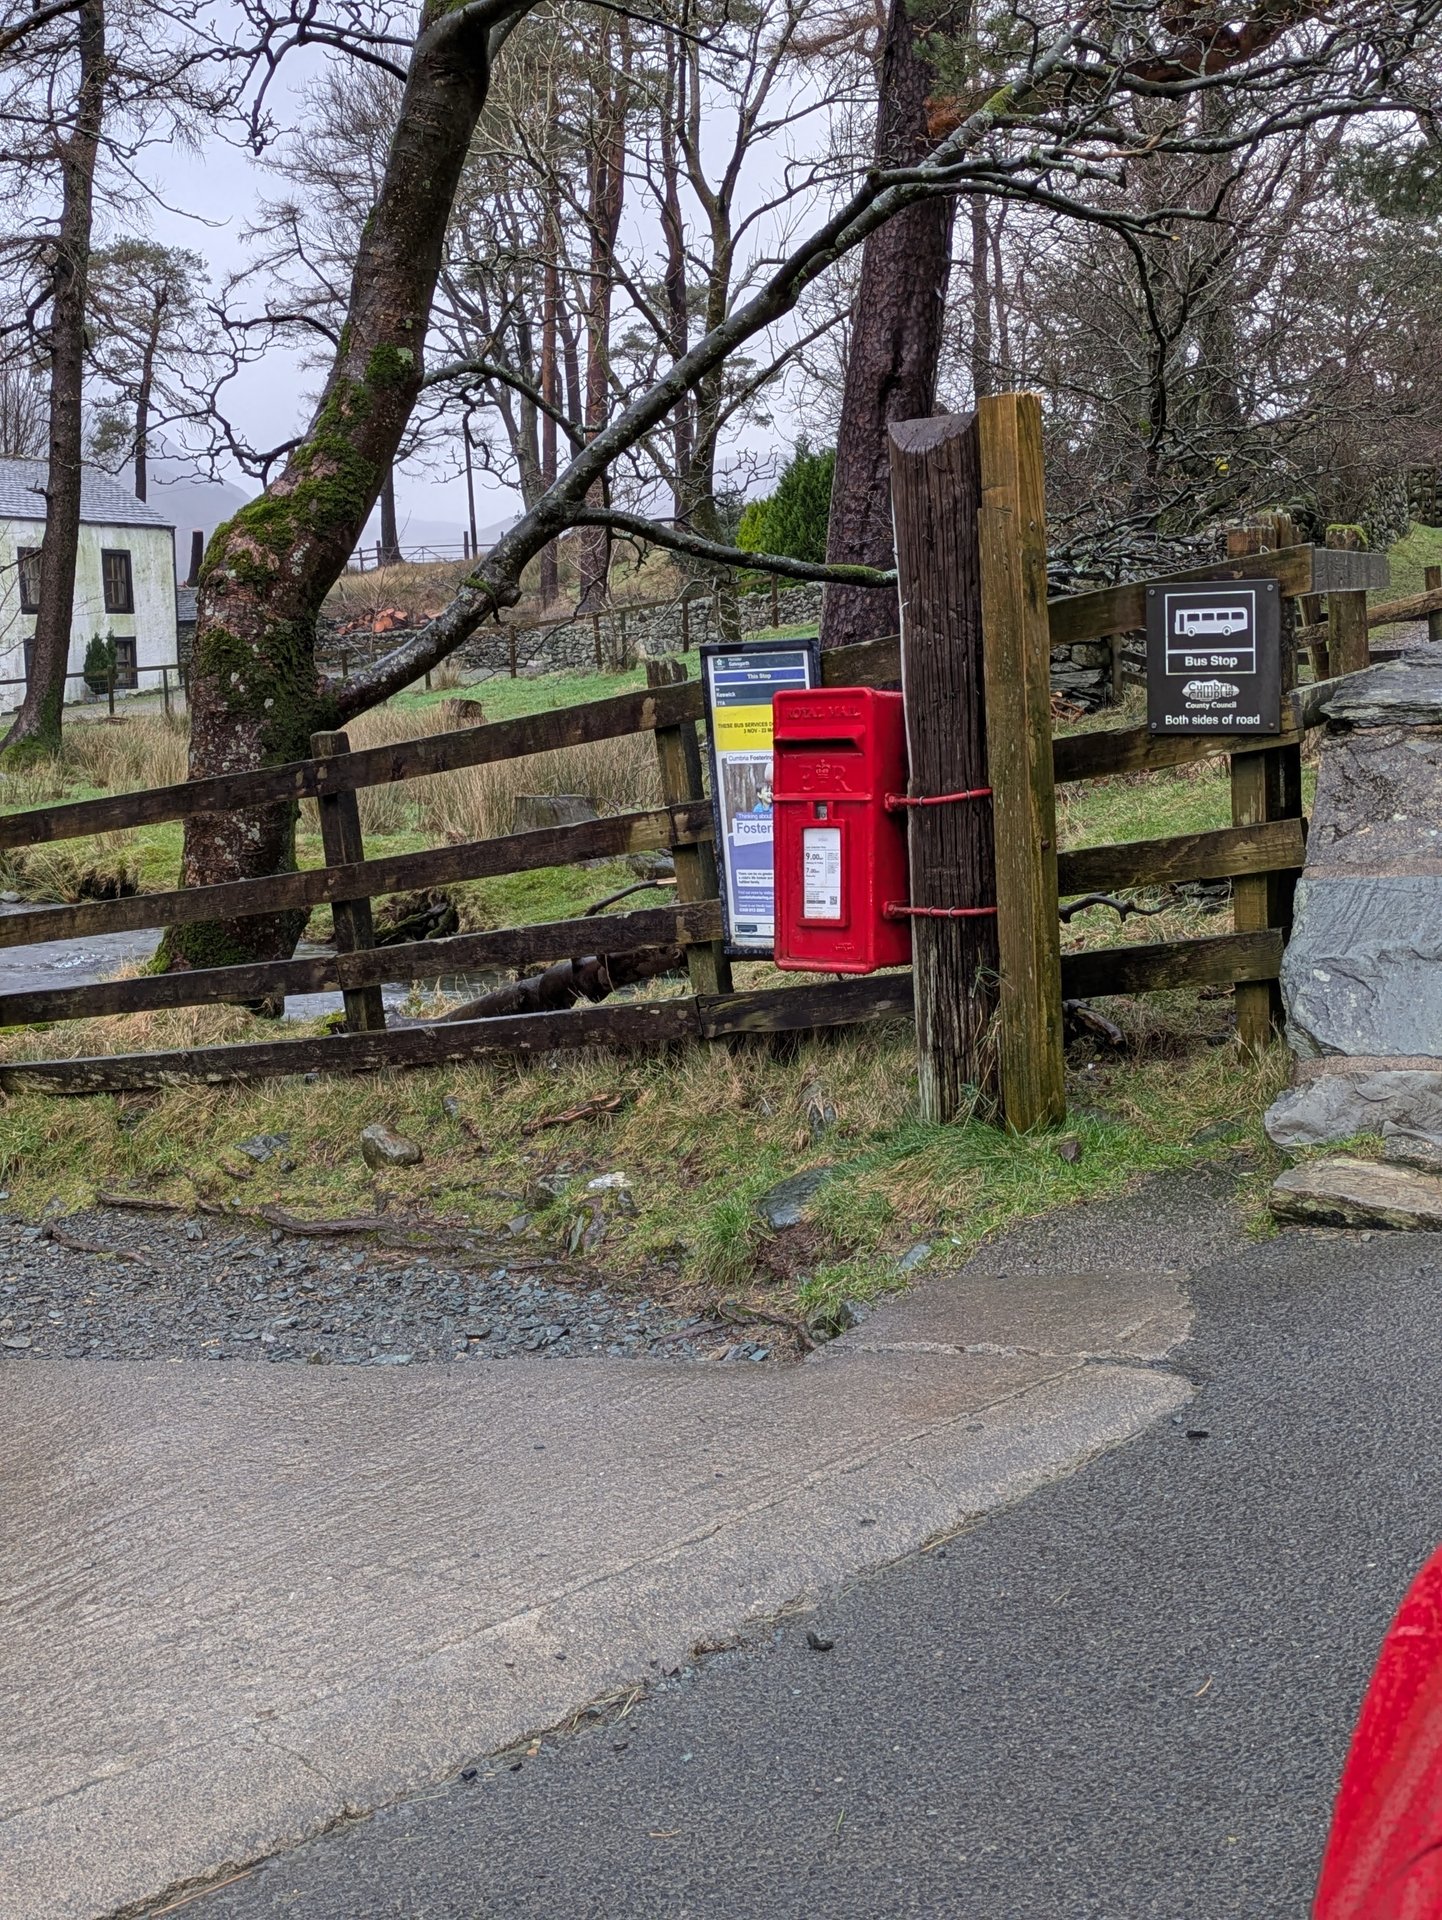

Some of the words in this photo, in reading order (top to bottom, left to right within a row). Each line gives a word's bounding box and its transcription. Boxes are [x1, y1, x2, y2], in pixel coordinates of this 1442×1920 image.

[1185, 656, 1208, 666] Bus
[1210, 655, 1238, 668] Stop
[1188, 681, 1234, 691] Cumbria
[1186, 702, 1210, 710] County
[1165, 714, 1189, 725] Both
[1192, 714, 1218, 724] sides
[1222, 714, 1233, 724] of
[1236, 714, 1260, 724] road
